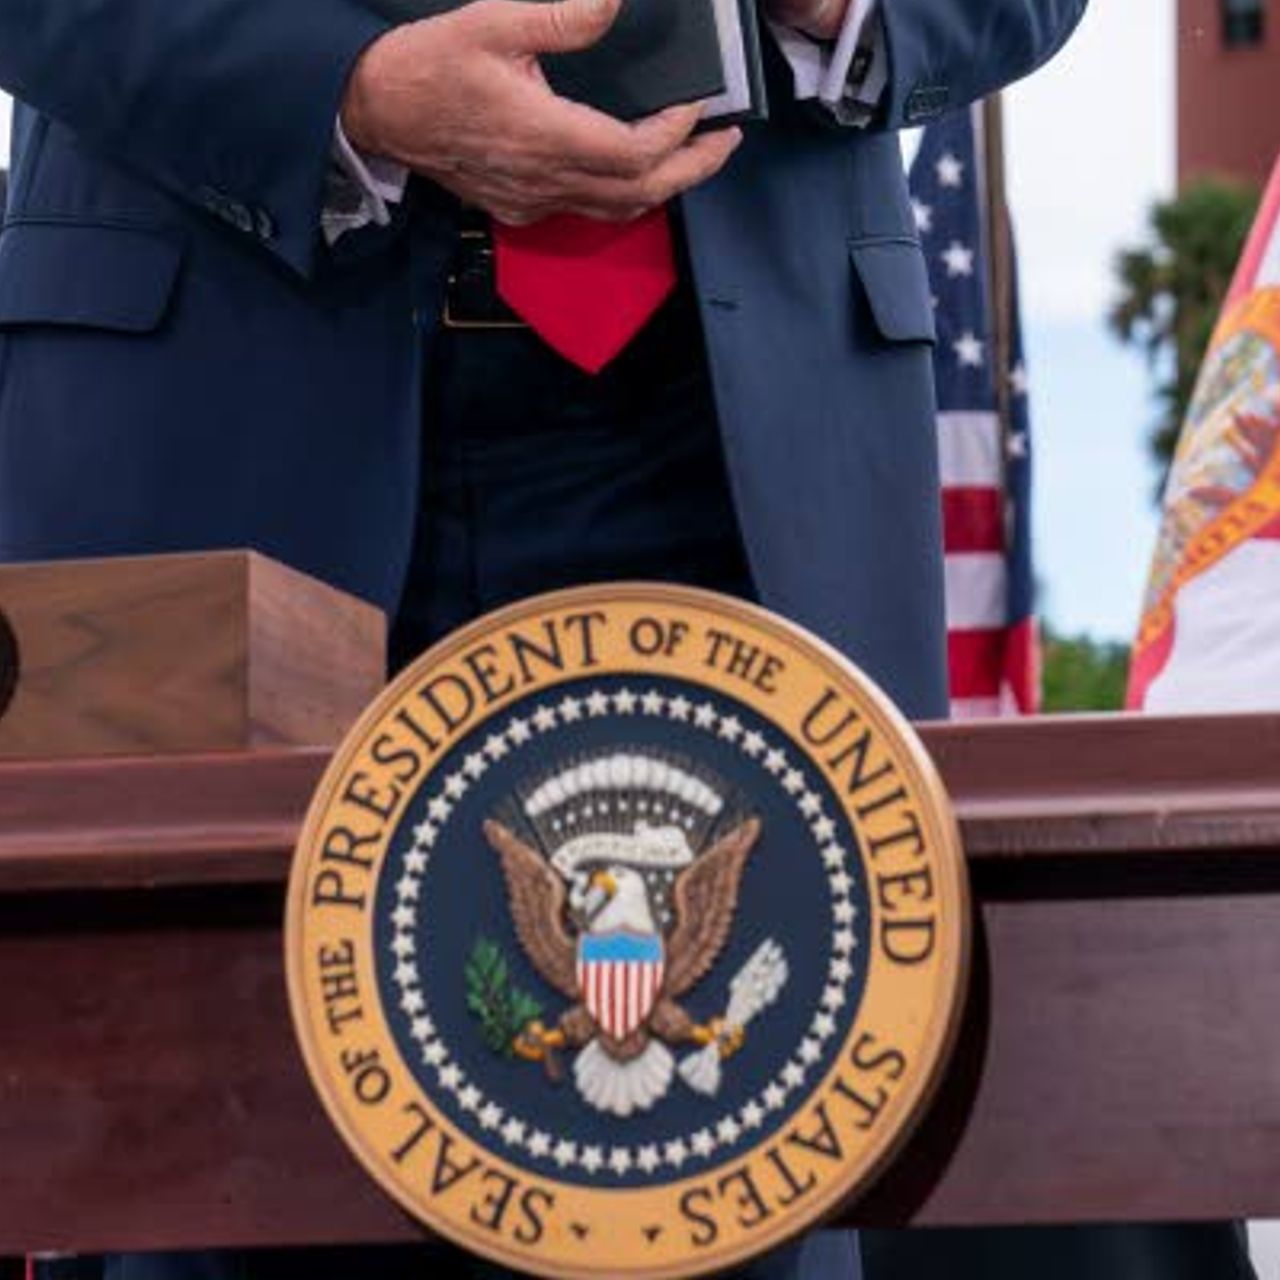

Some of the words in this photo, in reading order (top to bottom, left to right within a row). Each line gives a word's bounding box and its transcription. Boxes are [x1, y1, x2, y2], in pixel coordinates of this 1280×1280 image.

[628, 617, 689, 657] OF
[706, 629, 784, 693] THE
[311, 611, 606, 911] PRESIDENT
[800, 688, 936, 966] UNITED
[319, 939, 363, 1035] THE
[340, 1050, 392, 1105] OF
[393, 1101, 556, 1244] SEAL
[678, 1032, 907, 1244] STATES
